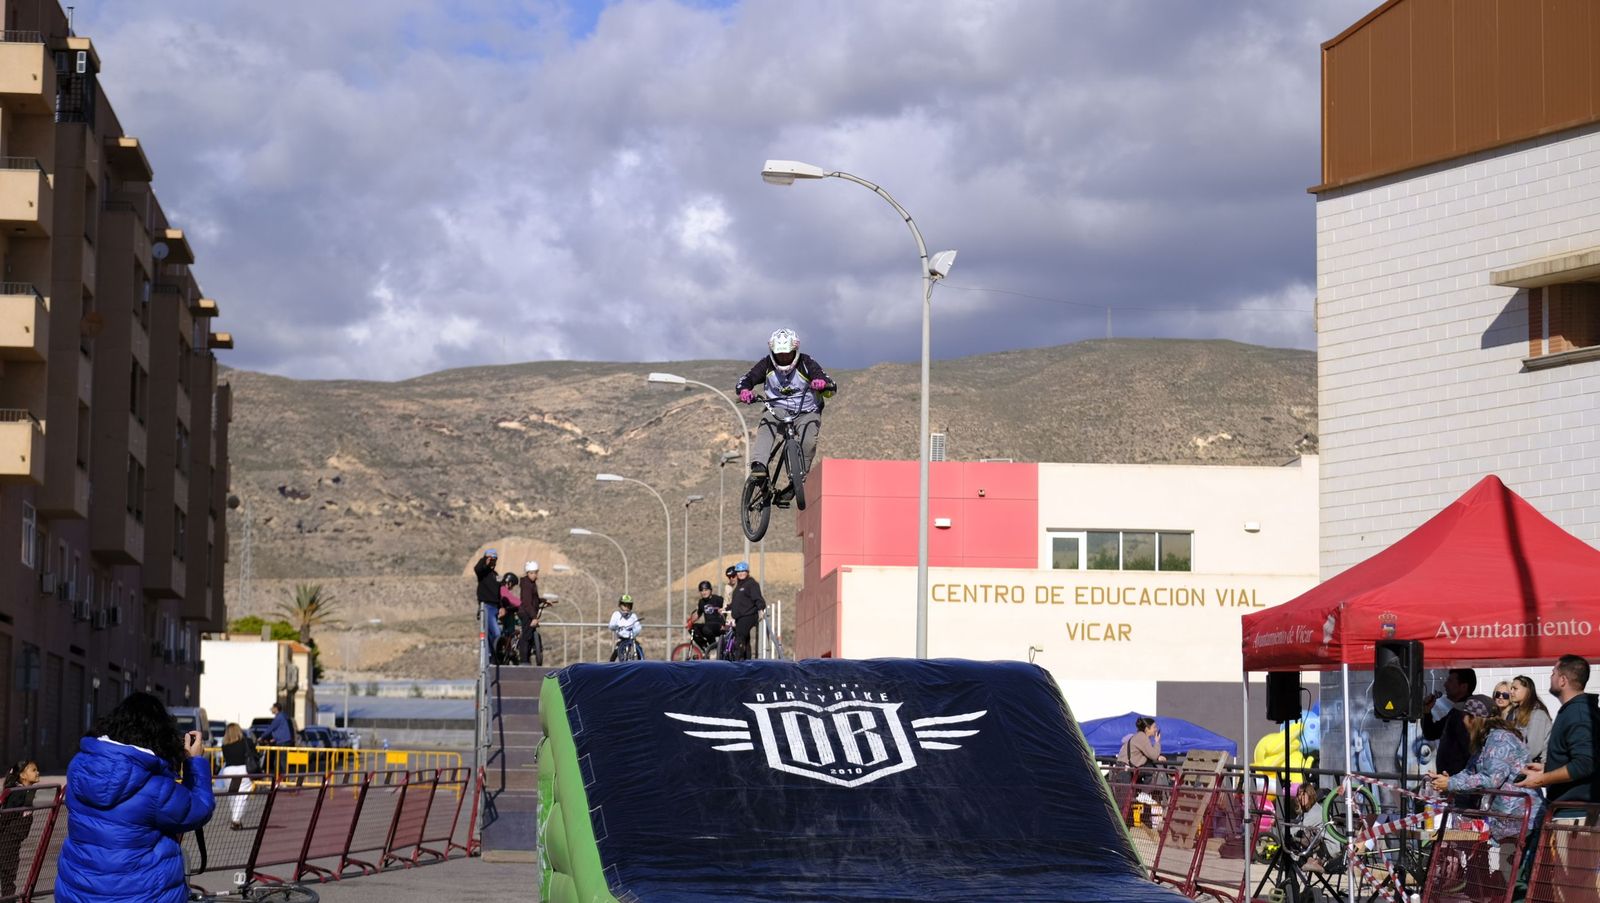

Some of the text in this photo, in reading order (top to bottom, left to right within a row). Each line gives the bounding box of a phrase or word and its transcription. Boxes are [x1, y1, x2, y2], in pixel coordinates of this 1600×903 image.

[932, 584, 1025, 604] CENTRO
[1035, 586, 1065, 605] DE
[1215, 588, 1266, 607] VIAL
[1435, 616, 1592, 645] Ayuntamiento
[756, 691, 889, 702] DIRTYBIKE
